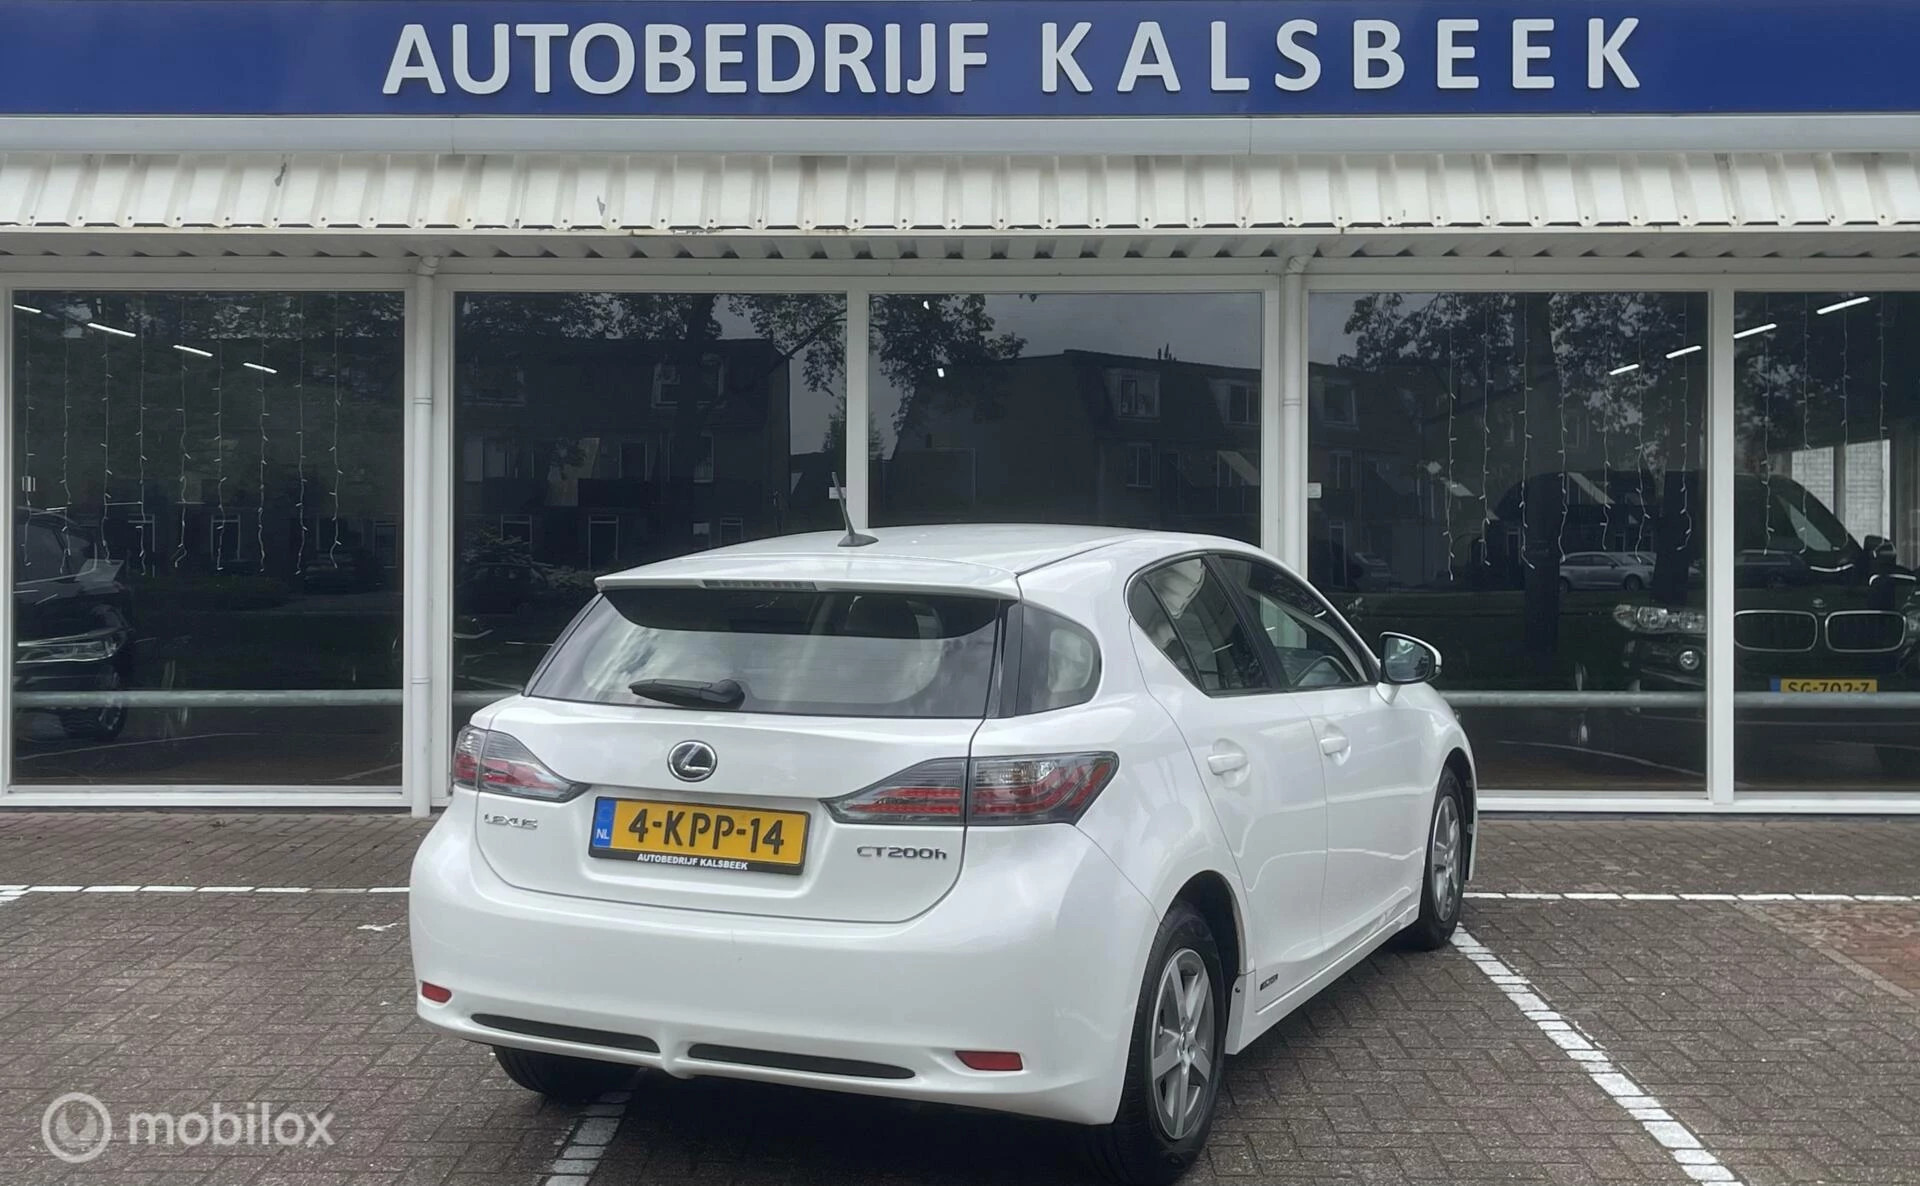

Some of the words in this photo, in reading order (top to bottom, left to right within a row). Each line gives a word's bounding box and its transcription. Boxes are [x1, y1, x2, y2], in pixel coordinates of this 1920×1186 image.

[383, 23, 988, 95] AUTOBEDRIJF
[1042, 17, 1640, 92] KALSBEEK
[596, 828, 610, 840] NL
[628, 808, 785, 855] 4-KPP-14
[637, 853, 698, 866] AUTOBEDRIJF
[699, 858, 748, 870] KALSBEEK
[856, 846, 947, 860] CT200h
